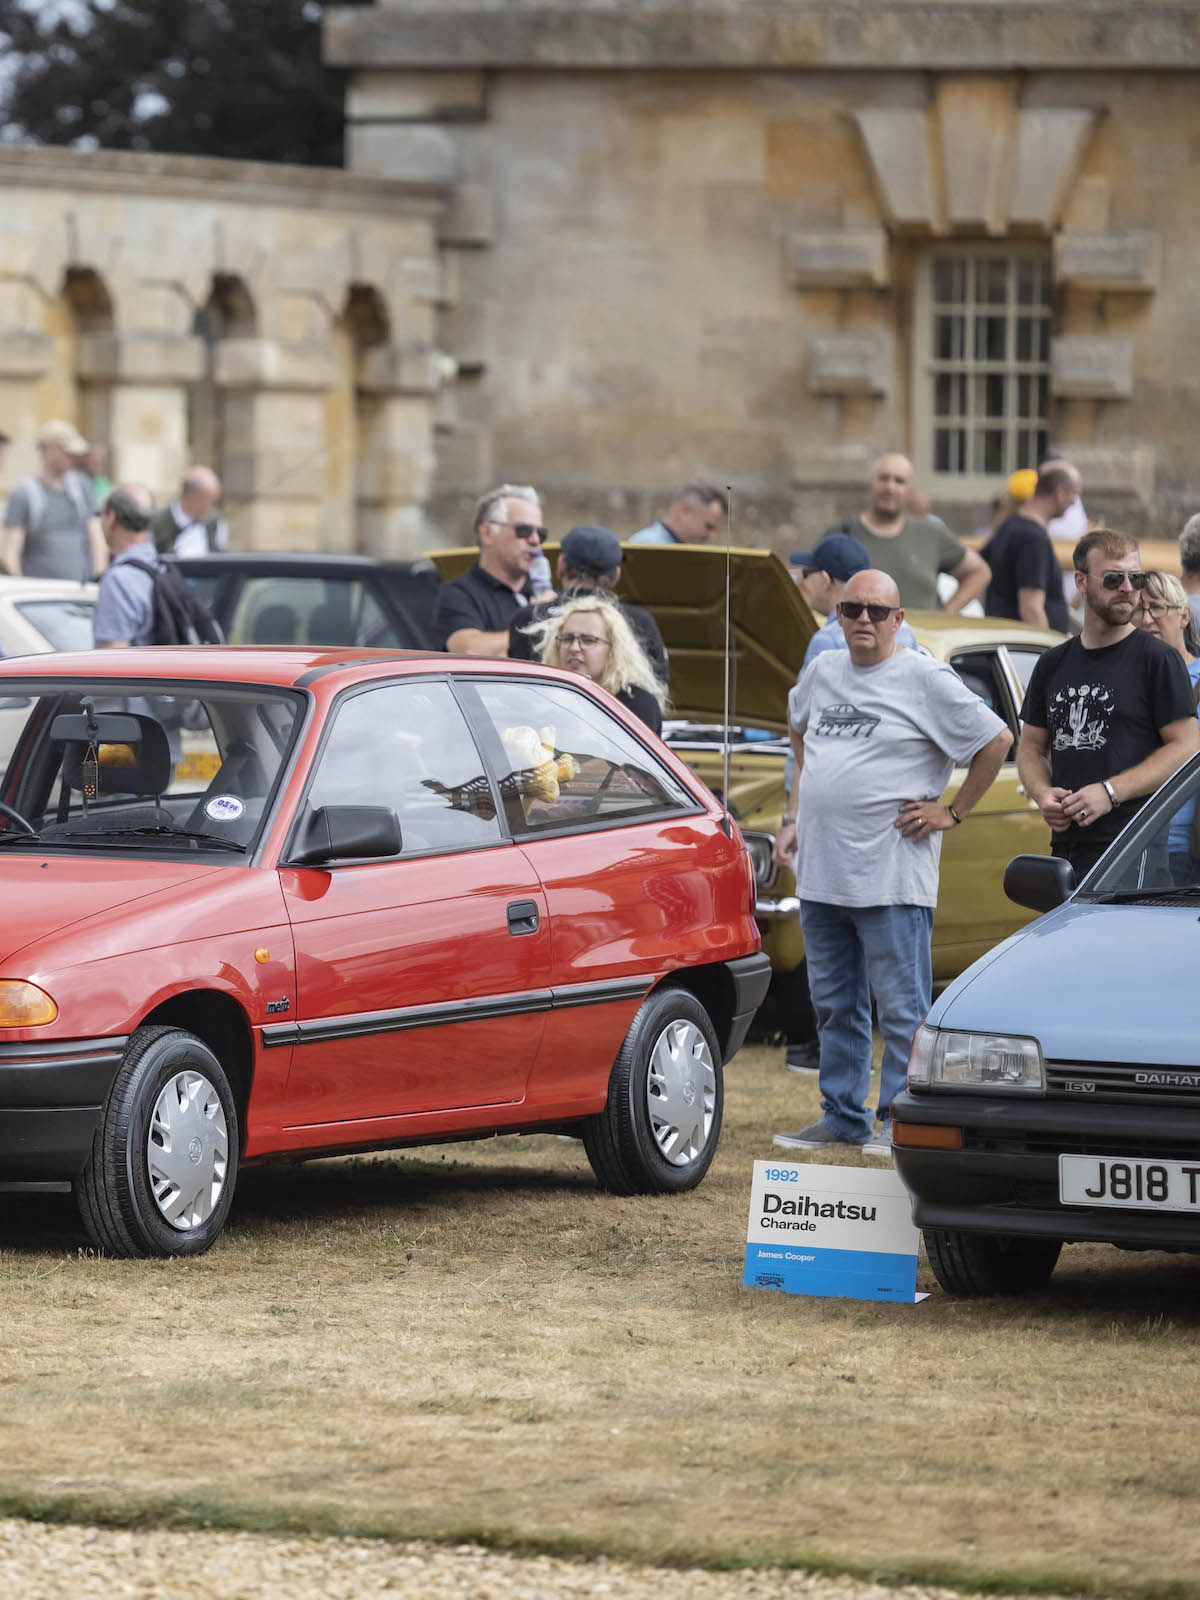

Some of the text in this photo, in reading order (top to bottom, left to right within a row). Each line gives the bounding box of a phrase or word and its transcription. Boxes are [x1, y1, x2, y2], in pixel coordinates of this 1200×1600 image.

[1065, 1082, 1096, 1092] 16V
[765, 1169, 799, 1182] 1992
[1085, 1162, 1168, 1202] J818
[763, 1193, 877, 1221] Daihatsu
[760, 1217, 817, 1232] Charade
[757, 1250, 816, 1263] James Cooper
